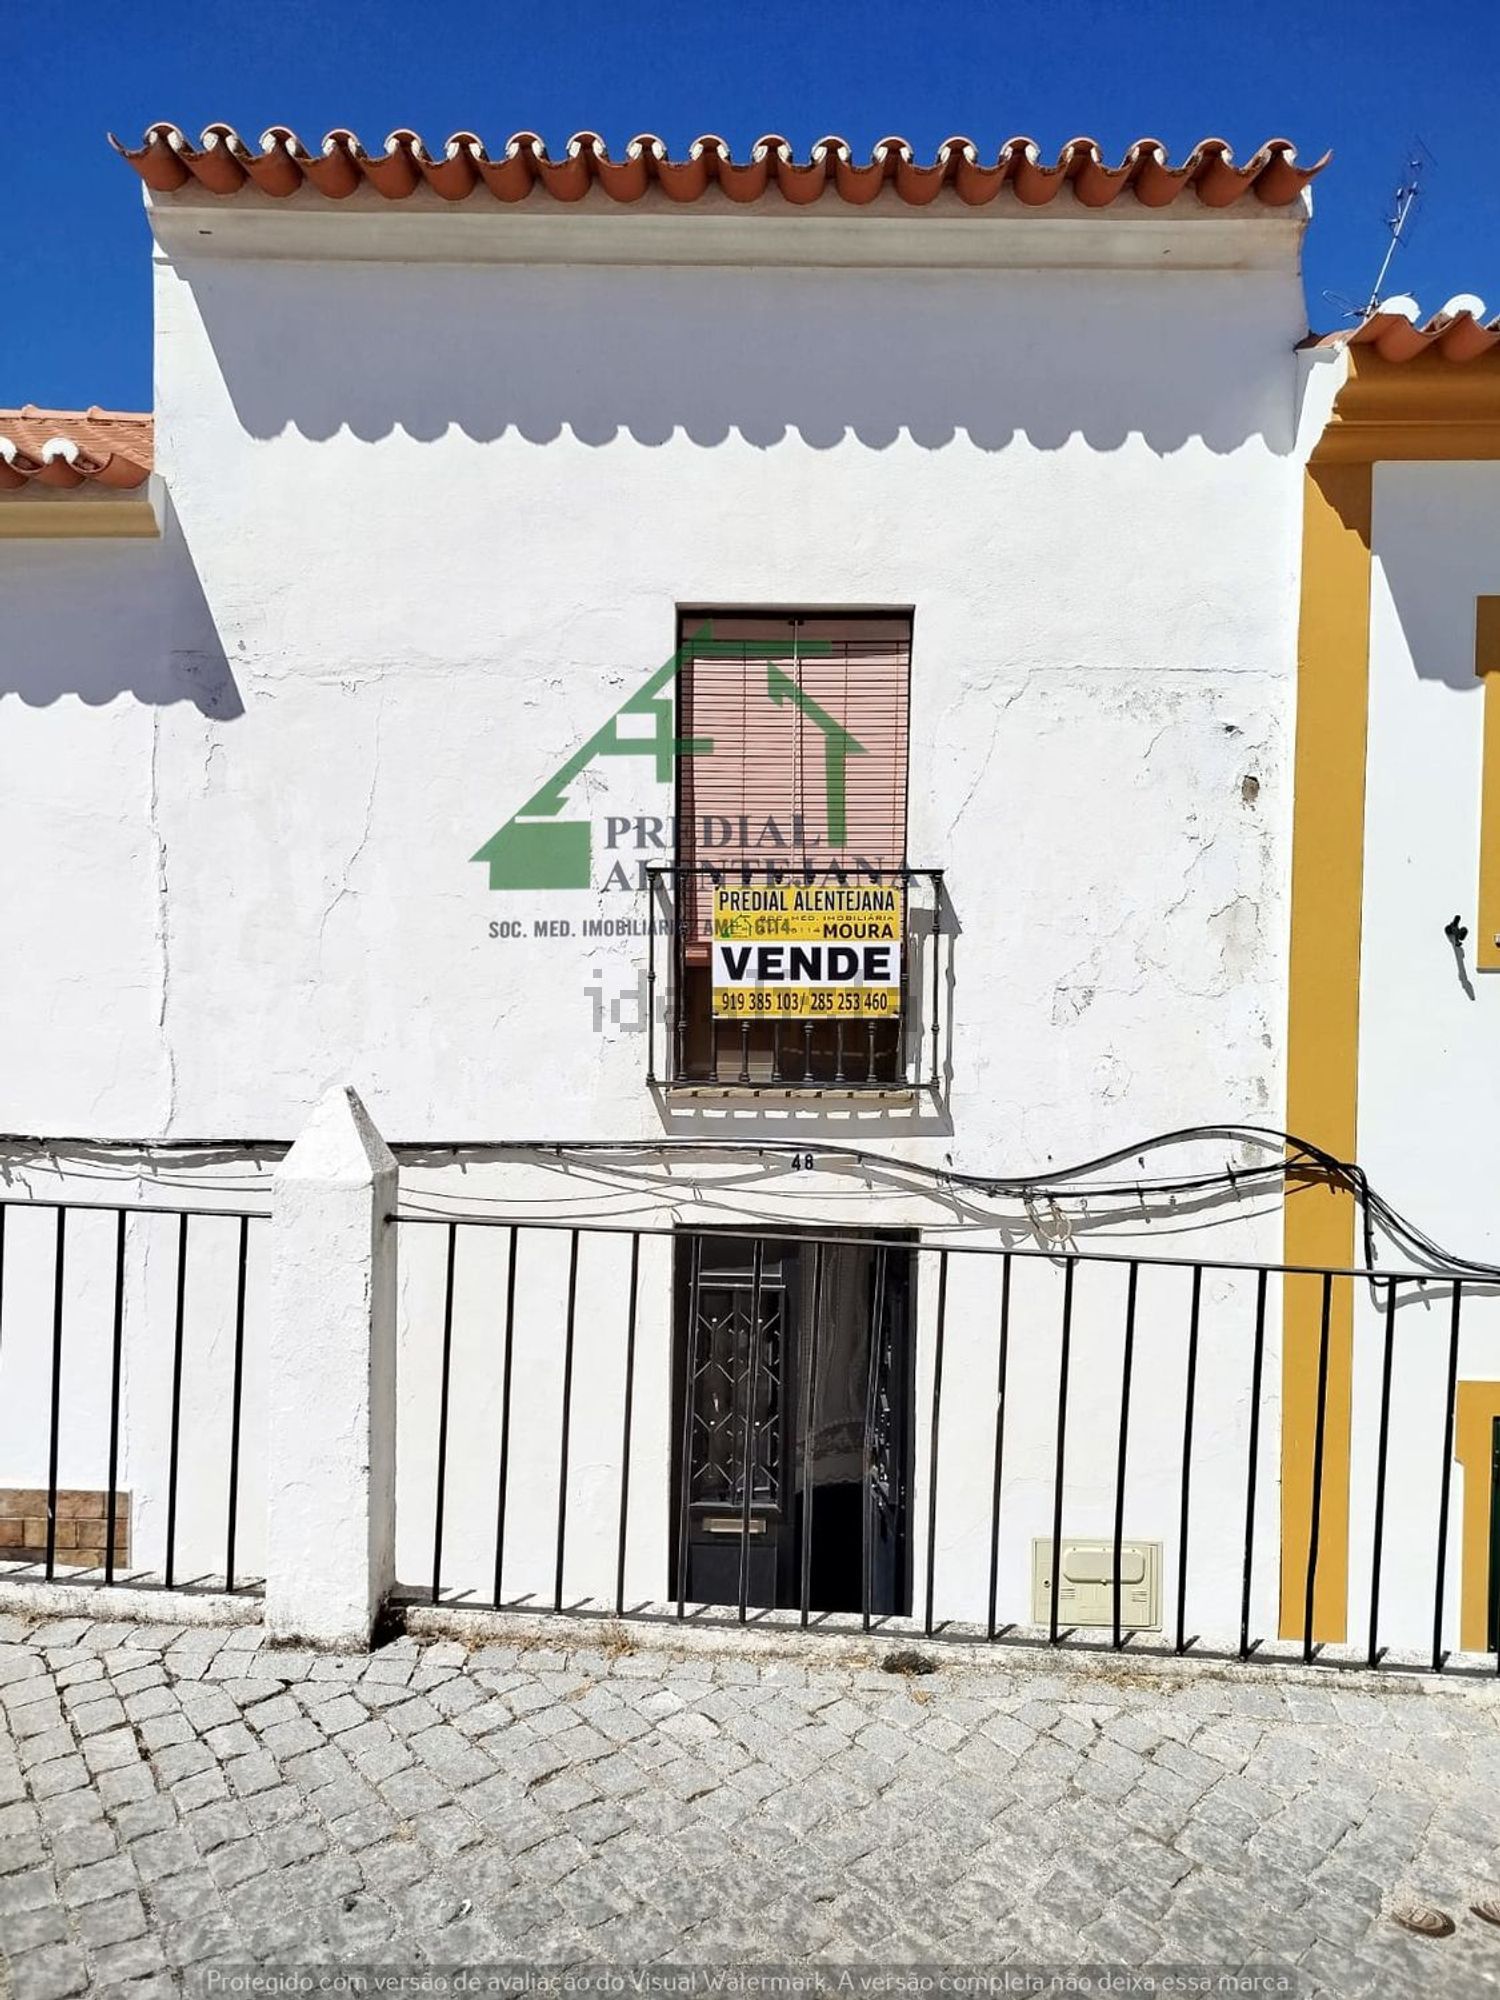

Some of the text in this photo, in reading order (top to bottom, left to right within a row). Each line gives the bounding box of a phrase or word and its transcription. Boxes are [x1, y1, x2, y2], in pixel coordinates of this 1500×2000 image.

[719, 890, 895, 911] PREDIAL ALENTEJANA
[823, 923, 894, 939] MOURA
[720, 946, 891, 981] VENDE
[722, 992, 745, 1011] 919
[749, 992, 771, 1011] 385
[811, 992, 833, 1011] 285
[838, 992, 860, 1011] 253
[864, 992, 887, 1011] 460
[791, 1153, 814, 1171] 48
